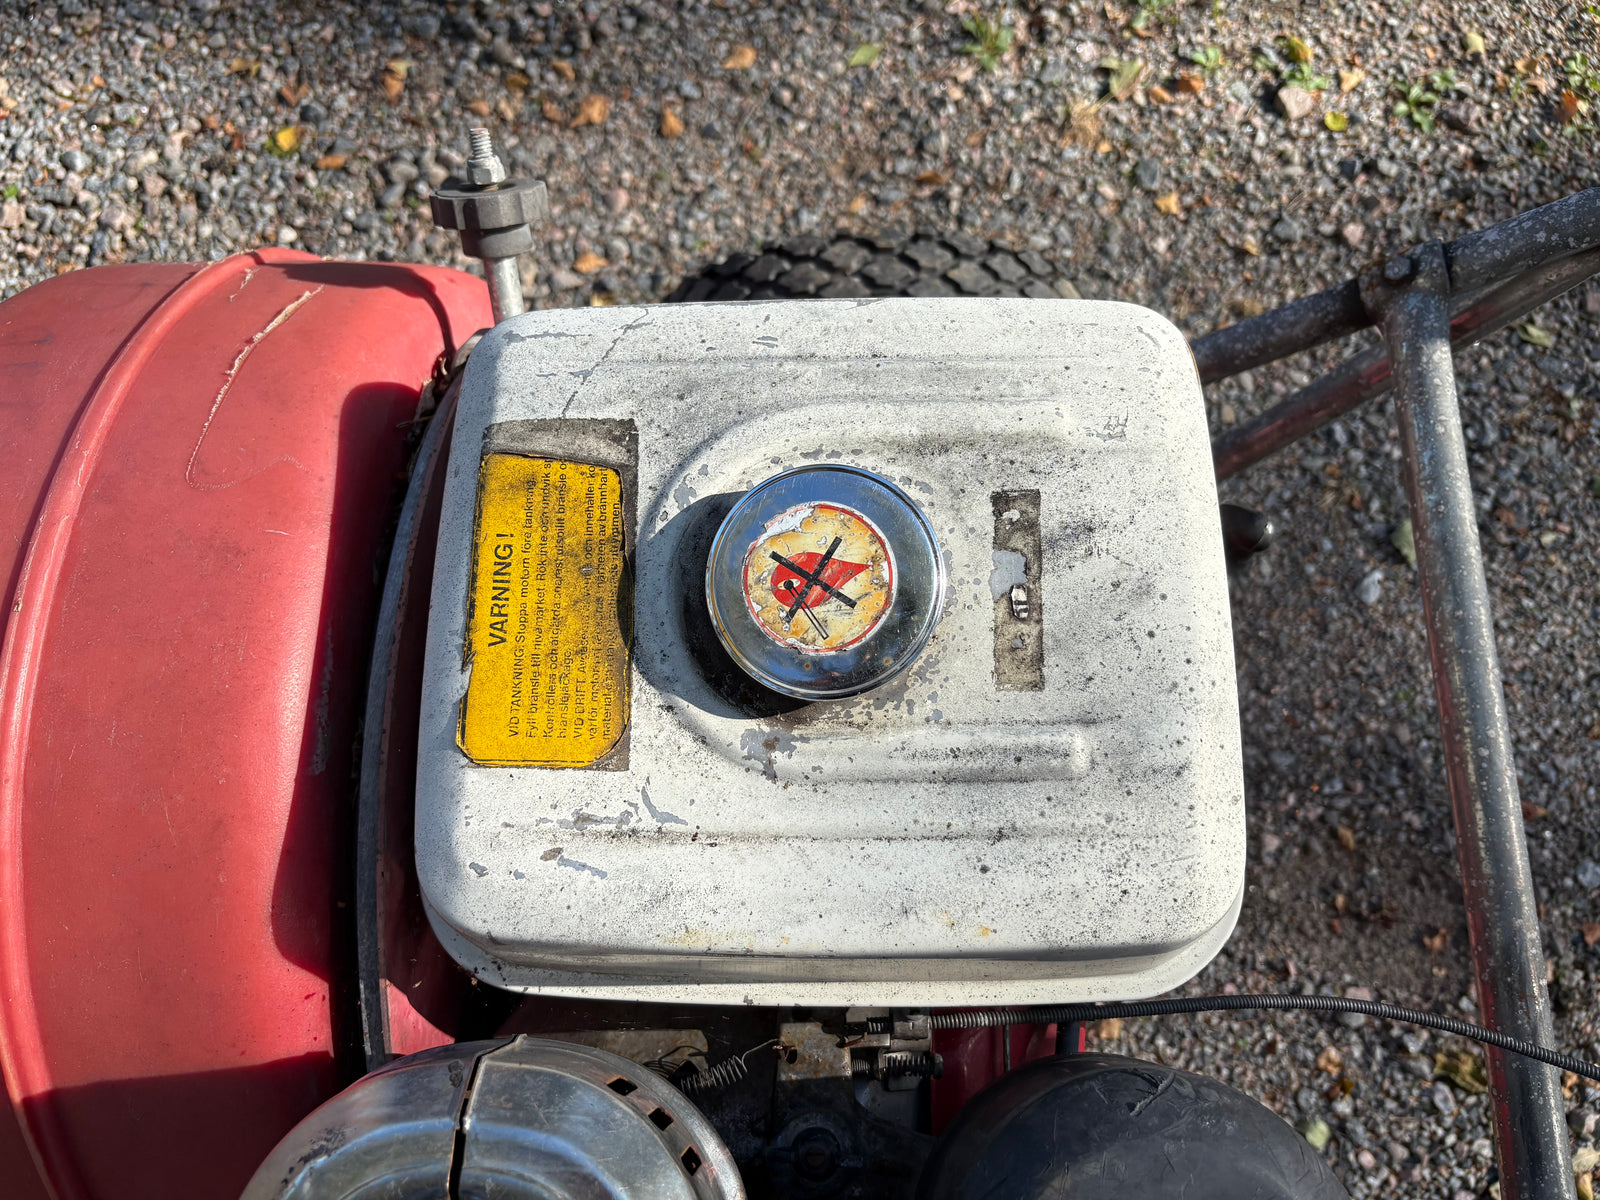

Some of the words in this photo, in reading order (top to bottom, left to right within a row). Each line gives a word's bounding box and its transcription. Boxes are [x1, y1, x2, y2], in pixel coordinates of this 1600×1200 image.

[560, 461, 567, 469] o
[541, 471, 550, 508] undvik
[556, 473, 567, 513] bränsle
[597, 466, 608, 521] brännbart
[521, 531, 532, 553] före
[599, 523, 606, 536] av
[537, 535, 548, 556] inte
[520, 557, 530, 597] motorn
[536, 558, 547, 580] Rök
[554, 557, 563, 598] snarast
[488, 531, 514, 647] VARNING!
[515, 601, 529, 642] Stoppa
[531, 653, 540, 667] till
[549, 648, 558, 669] och
[527, 670, 539, 713] bränsle
[543, 672, 556, 737] Kontrollera
[508, 715, 519, 737] VID
[525, 717, 538, 737] Fyll
[573, 717, 584, 738] VID
[601, 693, 612, 739] material
